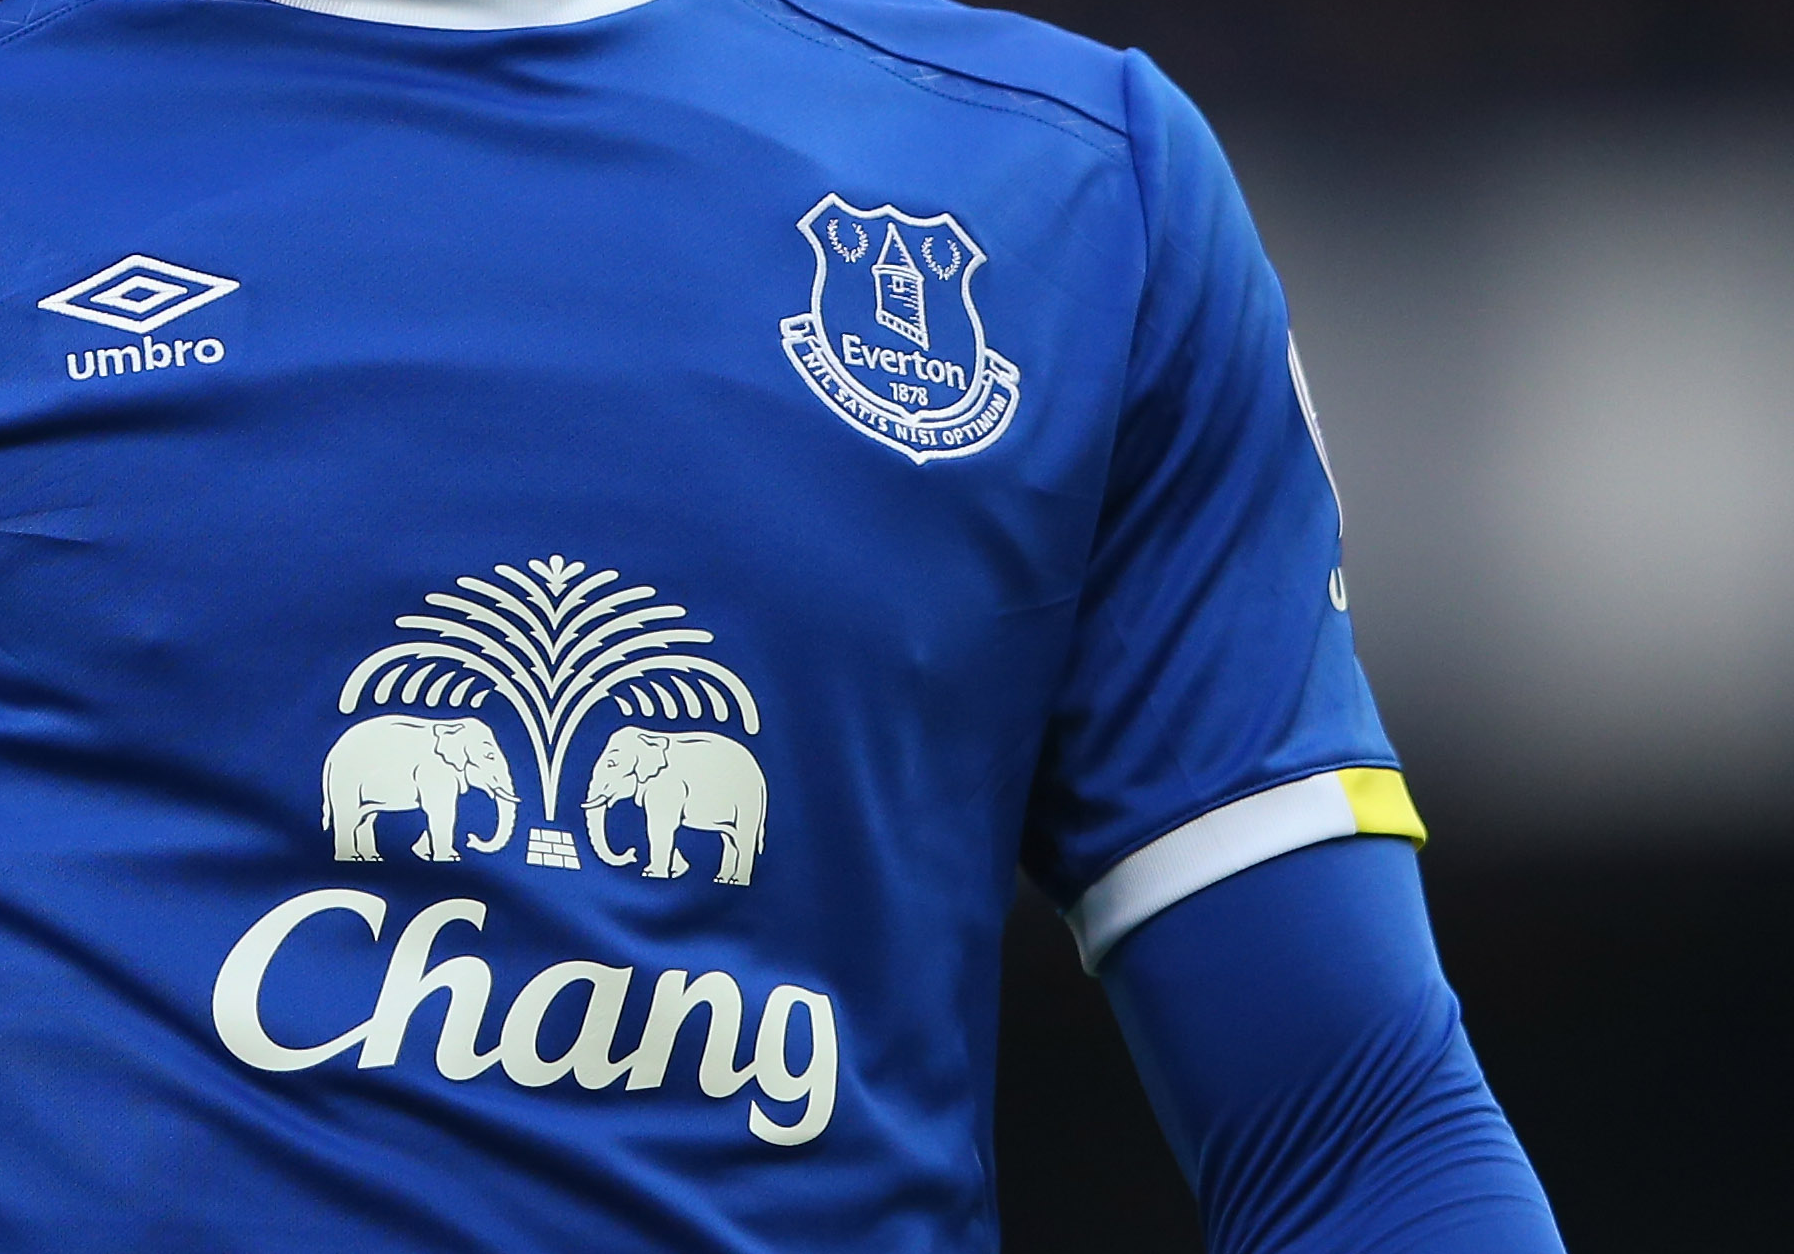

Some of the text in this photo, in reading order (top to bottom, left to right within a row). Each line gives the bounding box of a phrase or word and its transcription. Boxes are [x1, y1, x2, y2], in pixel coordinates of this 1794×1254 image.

[66, 335, 225, 380] umbro
[841, 333, 967, 390] Everton
[802, 351, 1007, 446] NIL SATIS NISI OPTIMUM
[889, 382, 929, 406] 1878
[212, 888, 839, 1147] Chang
